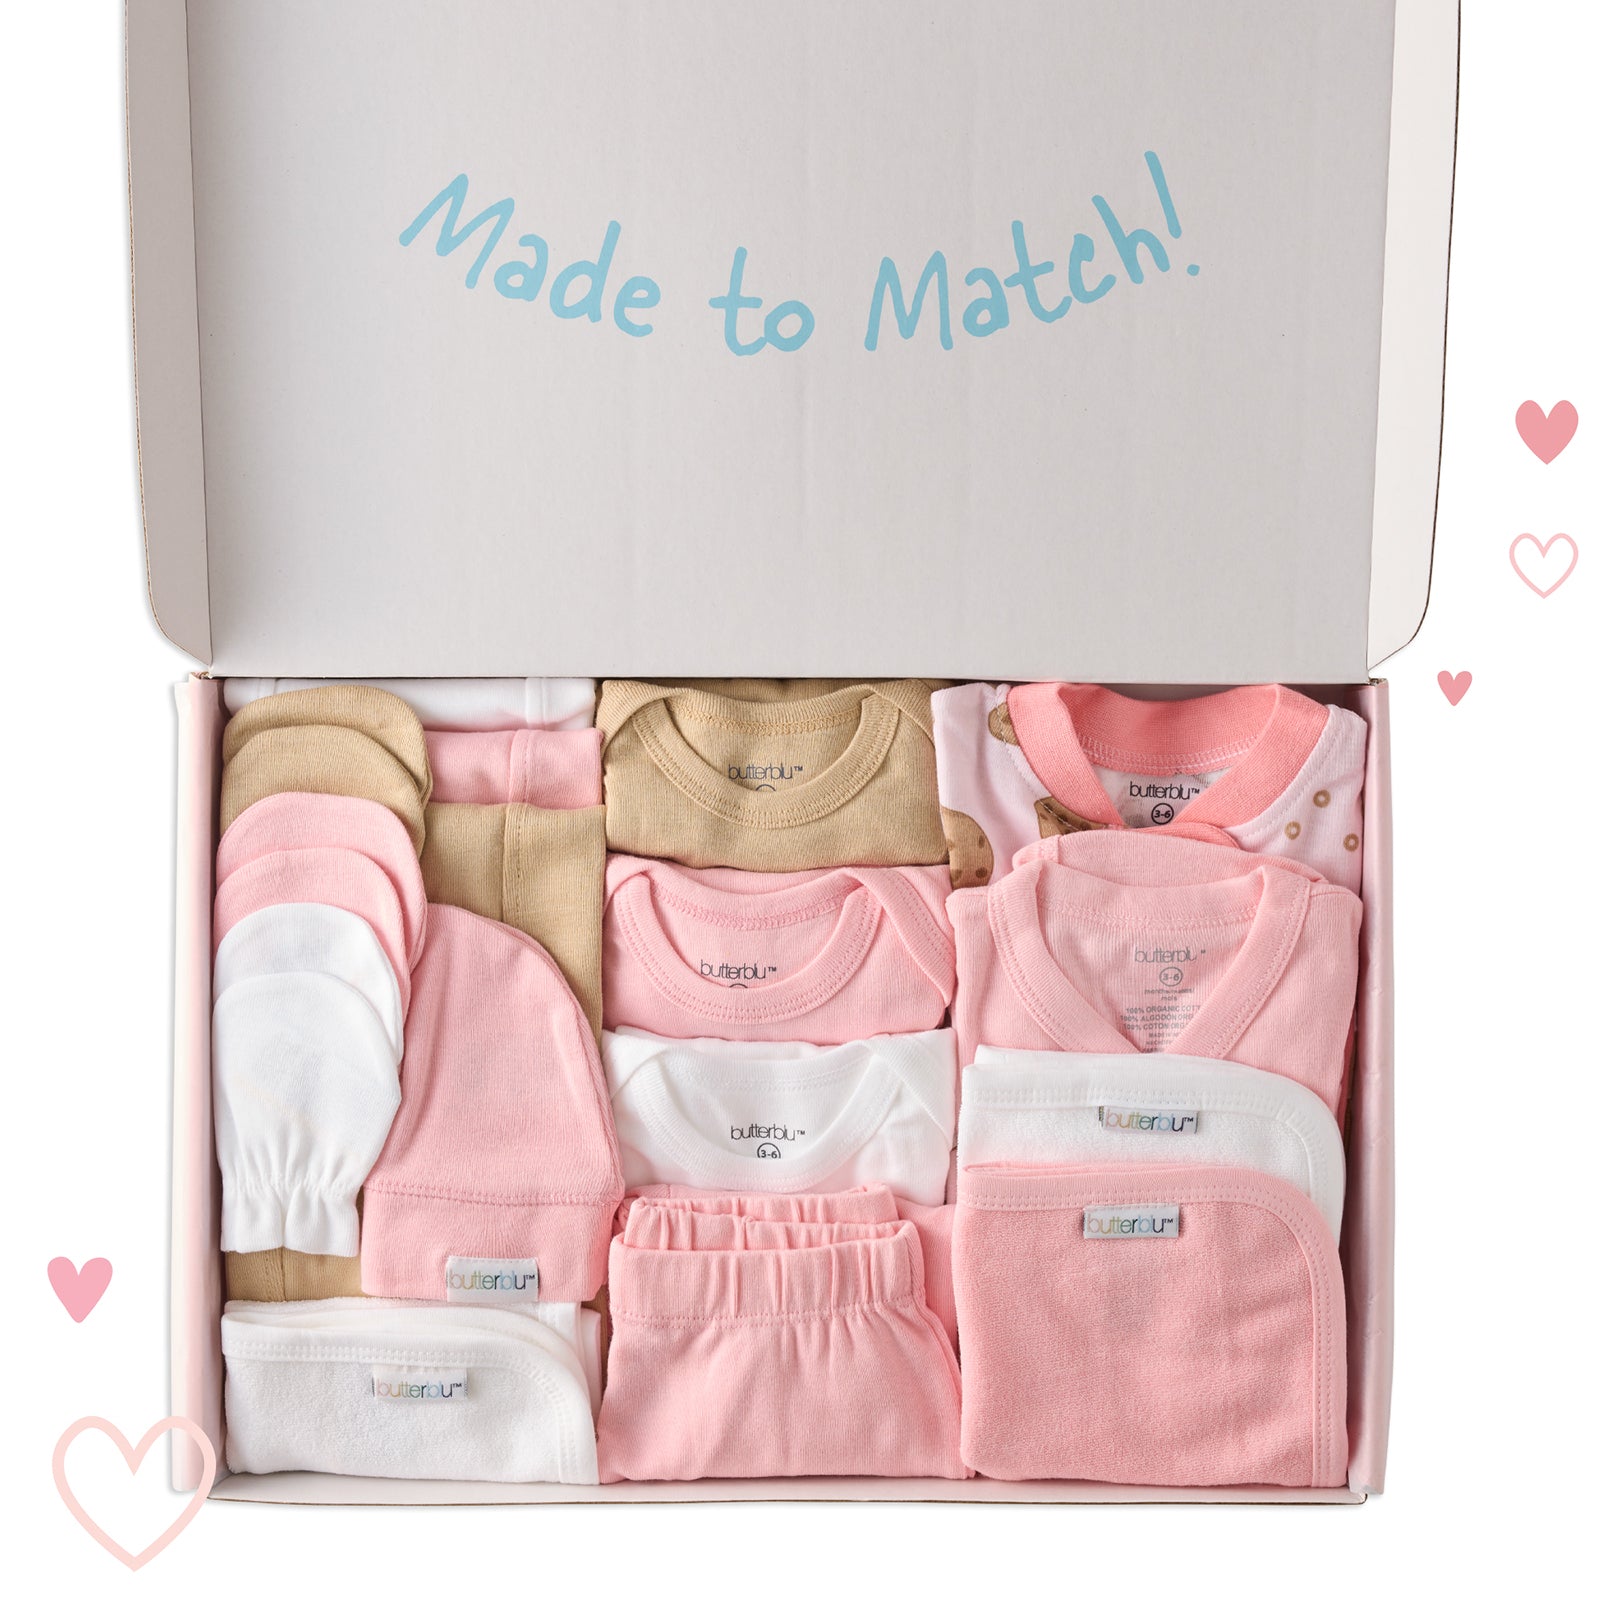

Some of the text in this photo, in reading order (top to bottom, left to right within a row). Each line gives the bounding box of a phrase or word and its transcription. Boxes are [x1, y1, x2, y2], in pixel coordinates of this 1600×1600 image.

[400, 151, 1199, 356] Made to Match!
[1154, 809, 1171, 818] 3-6
[1162, 973, 1180, 982] 3-6
[1145, 1005, 1180, 1014] ORGANIC
[1143, 1022, 1169, 1030] COTON
[760, 1149, 778, 1159] 3-6
